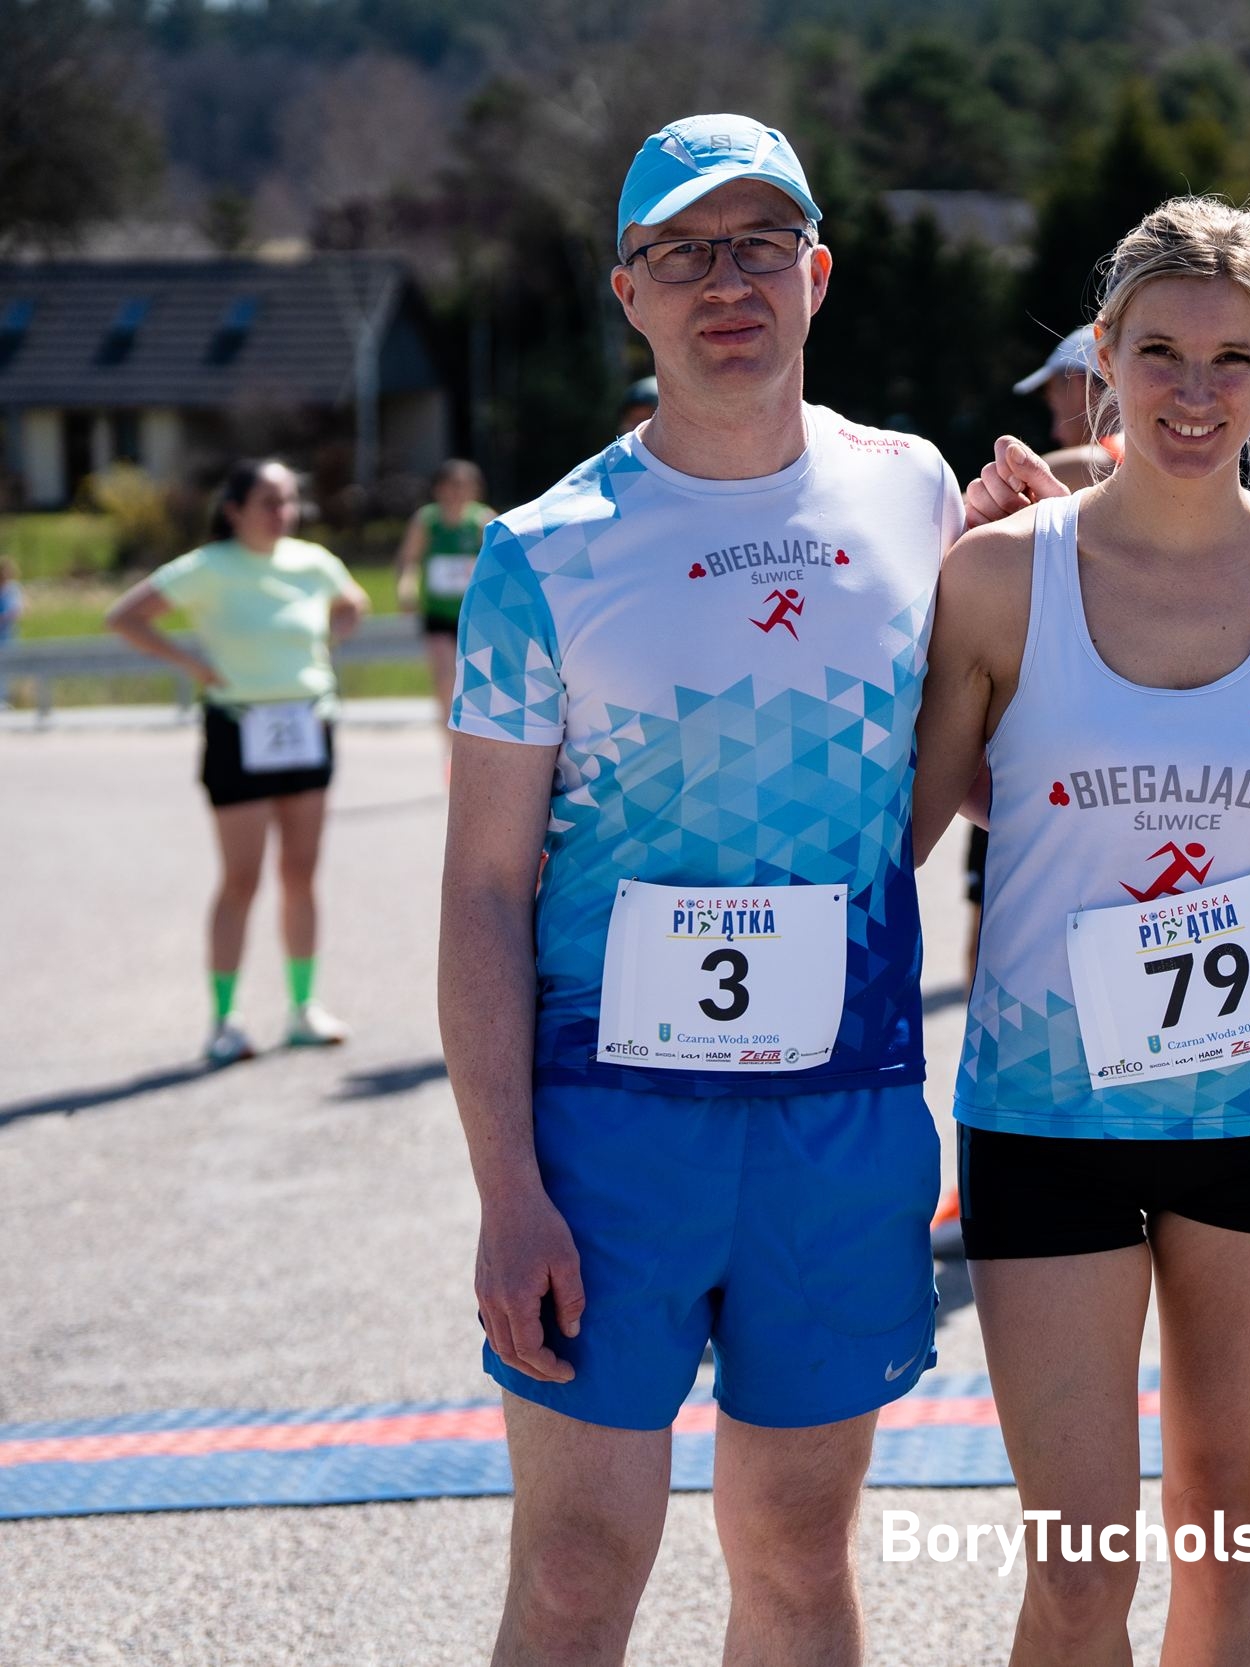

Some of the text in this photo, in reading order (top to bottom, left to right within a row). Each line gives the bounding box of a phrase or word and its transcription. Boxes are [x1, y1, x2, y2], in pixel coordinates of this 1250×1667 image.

[705, 540, 832, 577] BIEGAJĄCE
[751, 570, 804, 584] ŚLIWICE
[1134, 810, 1222, 831] ŚLIWICE
[698, 948, 750, 1022] 3
[1144, 942, 1250, 1029] 79
[677, 1033, 780, 1044] Czarna Woda 2026
[1167, 1036, 1205, 1051] Czarna
[1205, 1028, 1238, 1043] Woda
[610, 1041, 649, 1056] STEICO
[1198, 1048, 1223, 1059] HADM
[1102, 1060, 1143, 1076] STEICO
